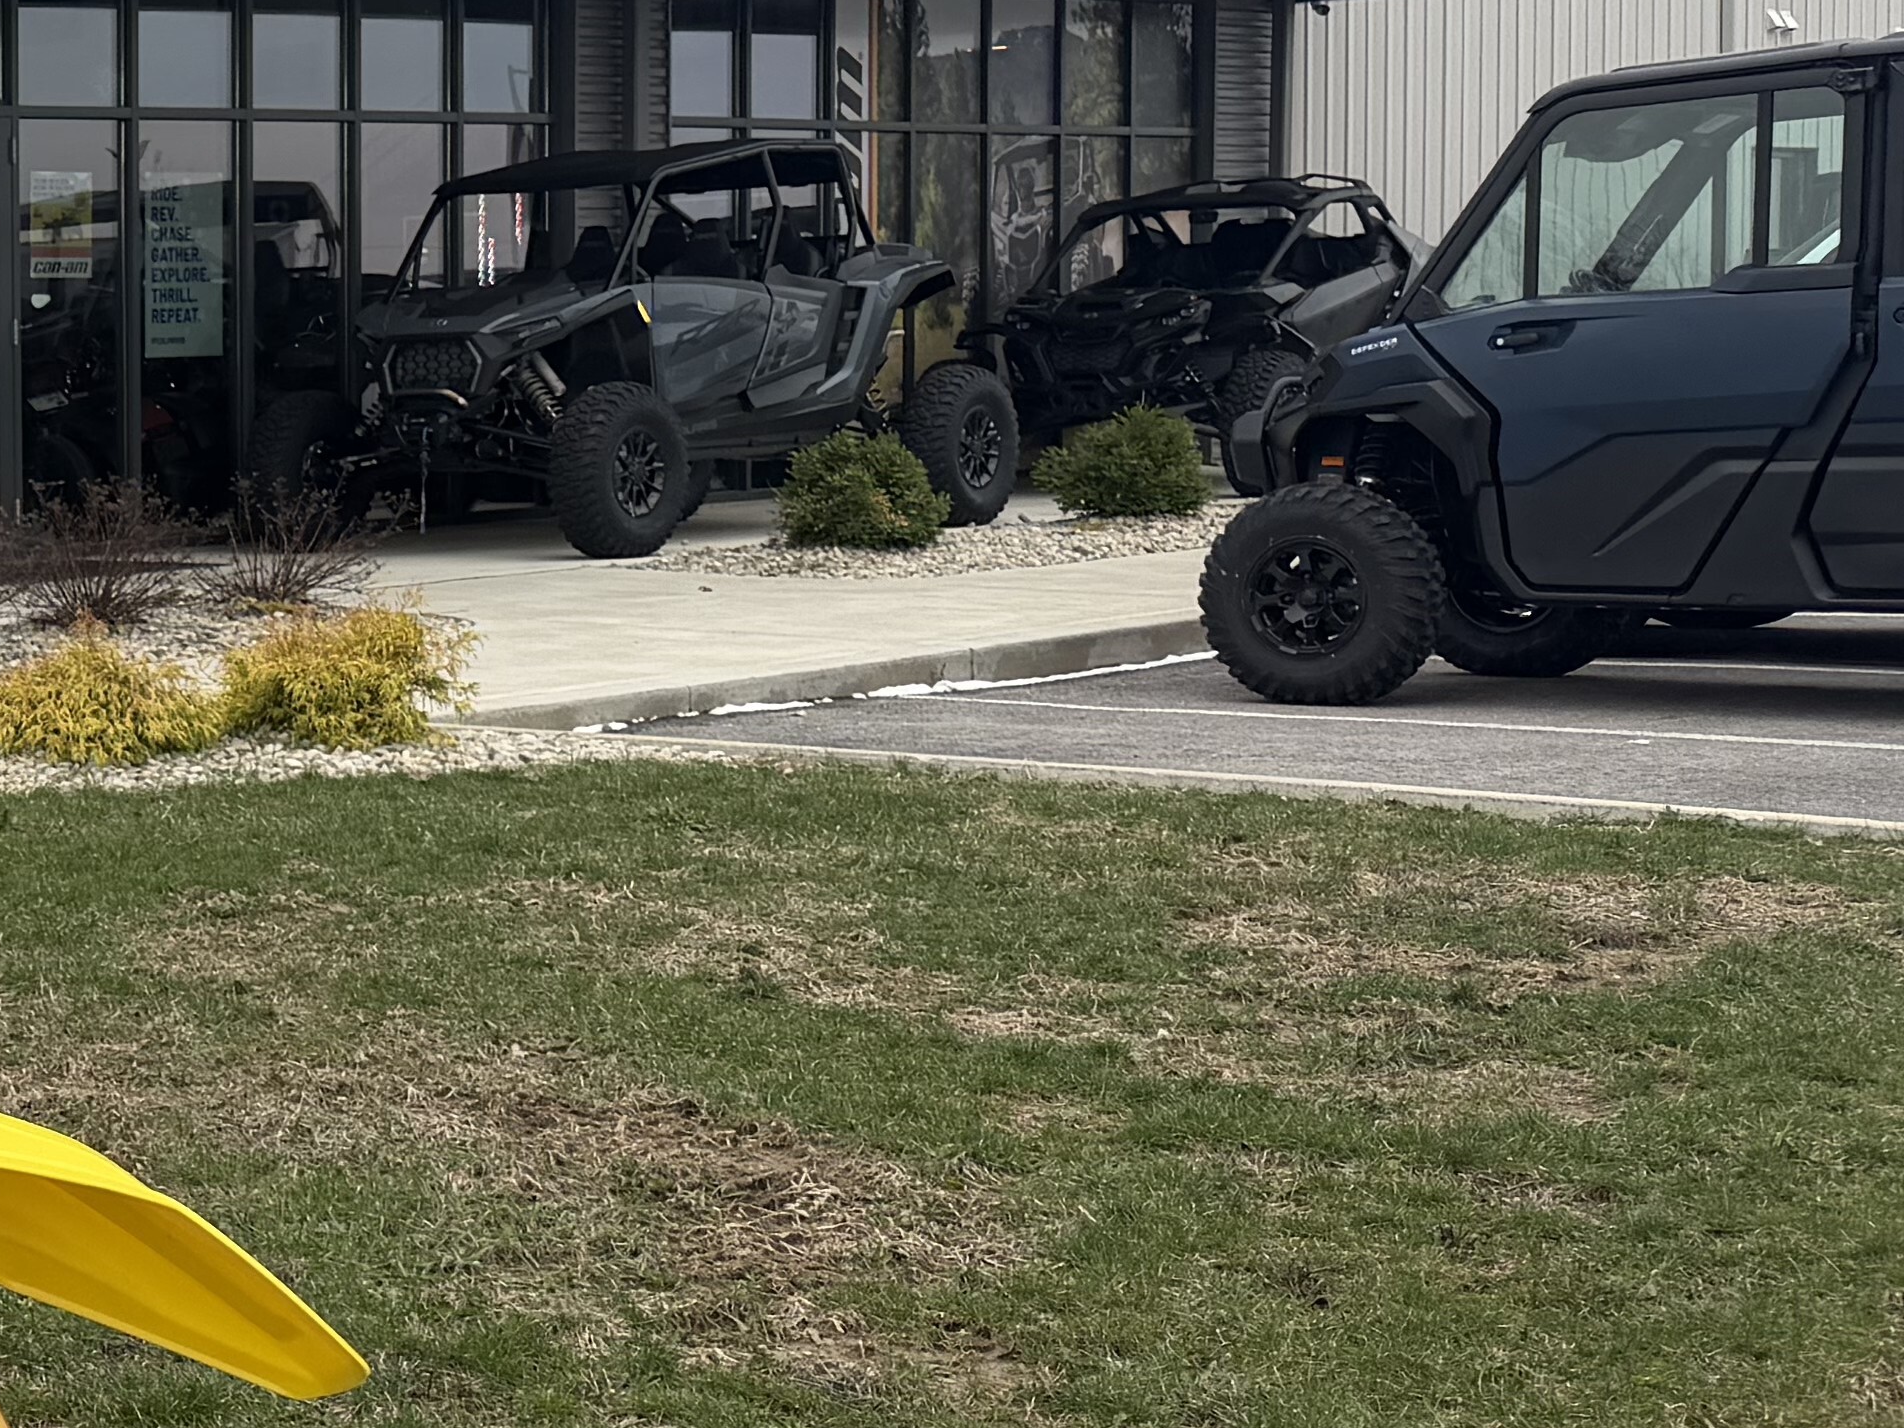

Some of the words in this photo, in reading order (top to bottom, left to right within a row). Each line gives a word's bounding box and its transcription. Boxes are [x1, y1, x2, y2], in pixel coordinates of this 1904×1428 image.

[151, 206, 179, 222] REV.
[151, 247, 203, 263] GATHER.
[151, 267, 210, 283] EXPLORE.
[152, 288, 198, 303] THRILL.
[152, 308, 201, 323] REPEAT.
